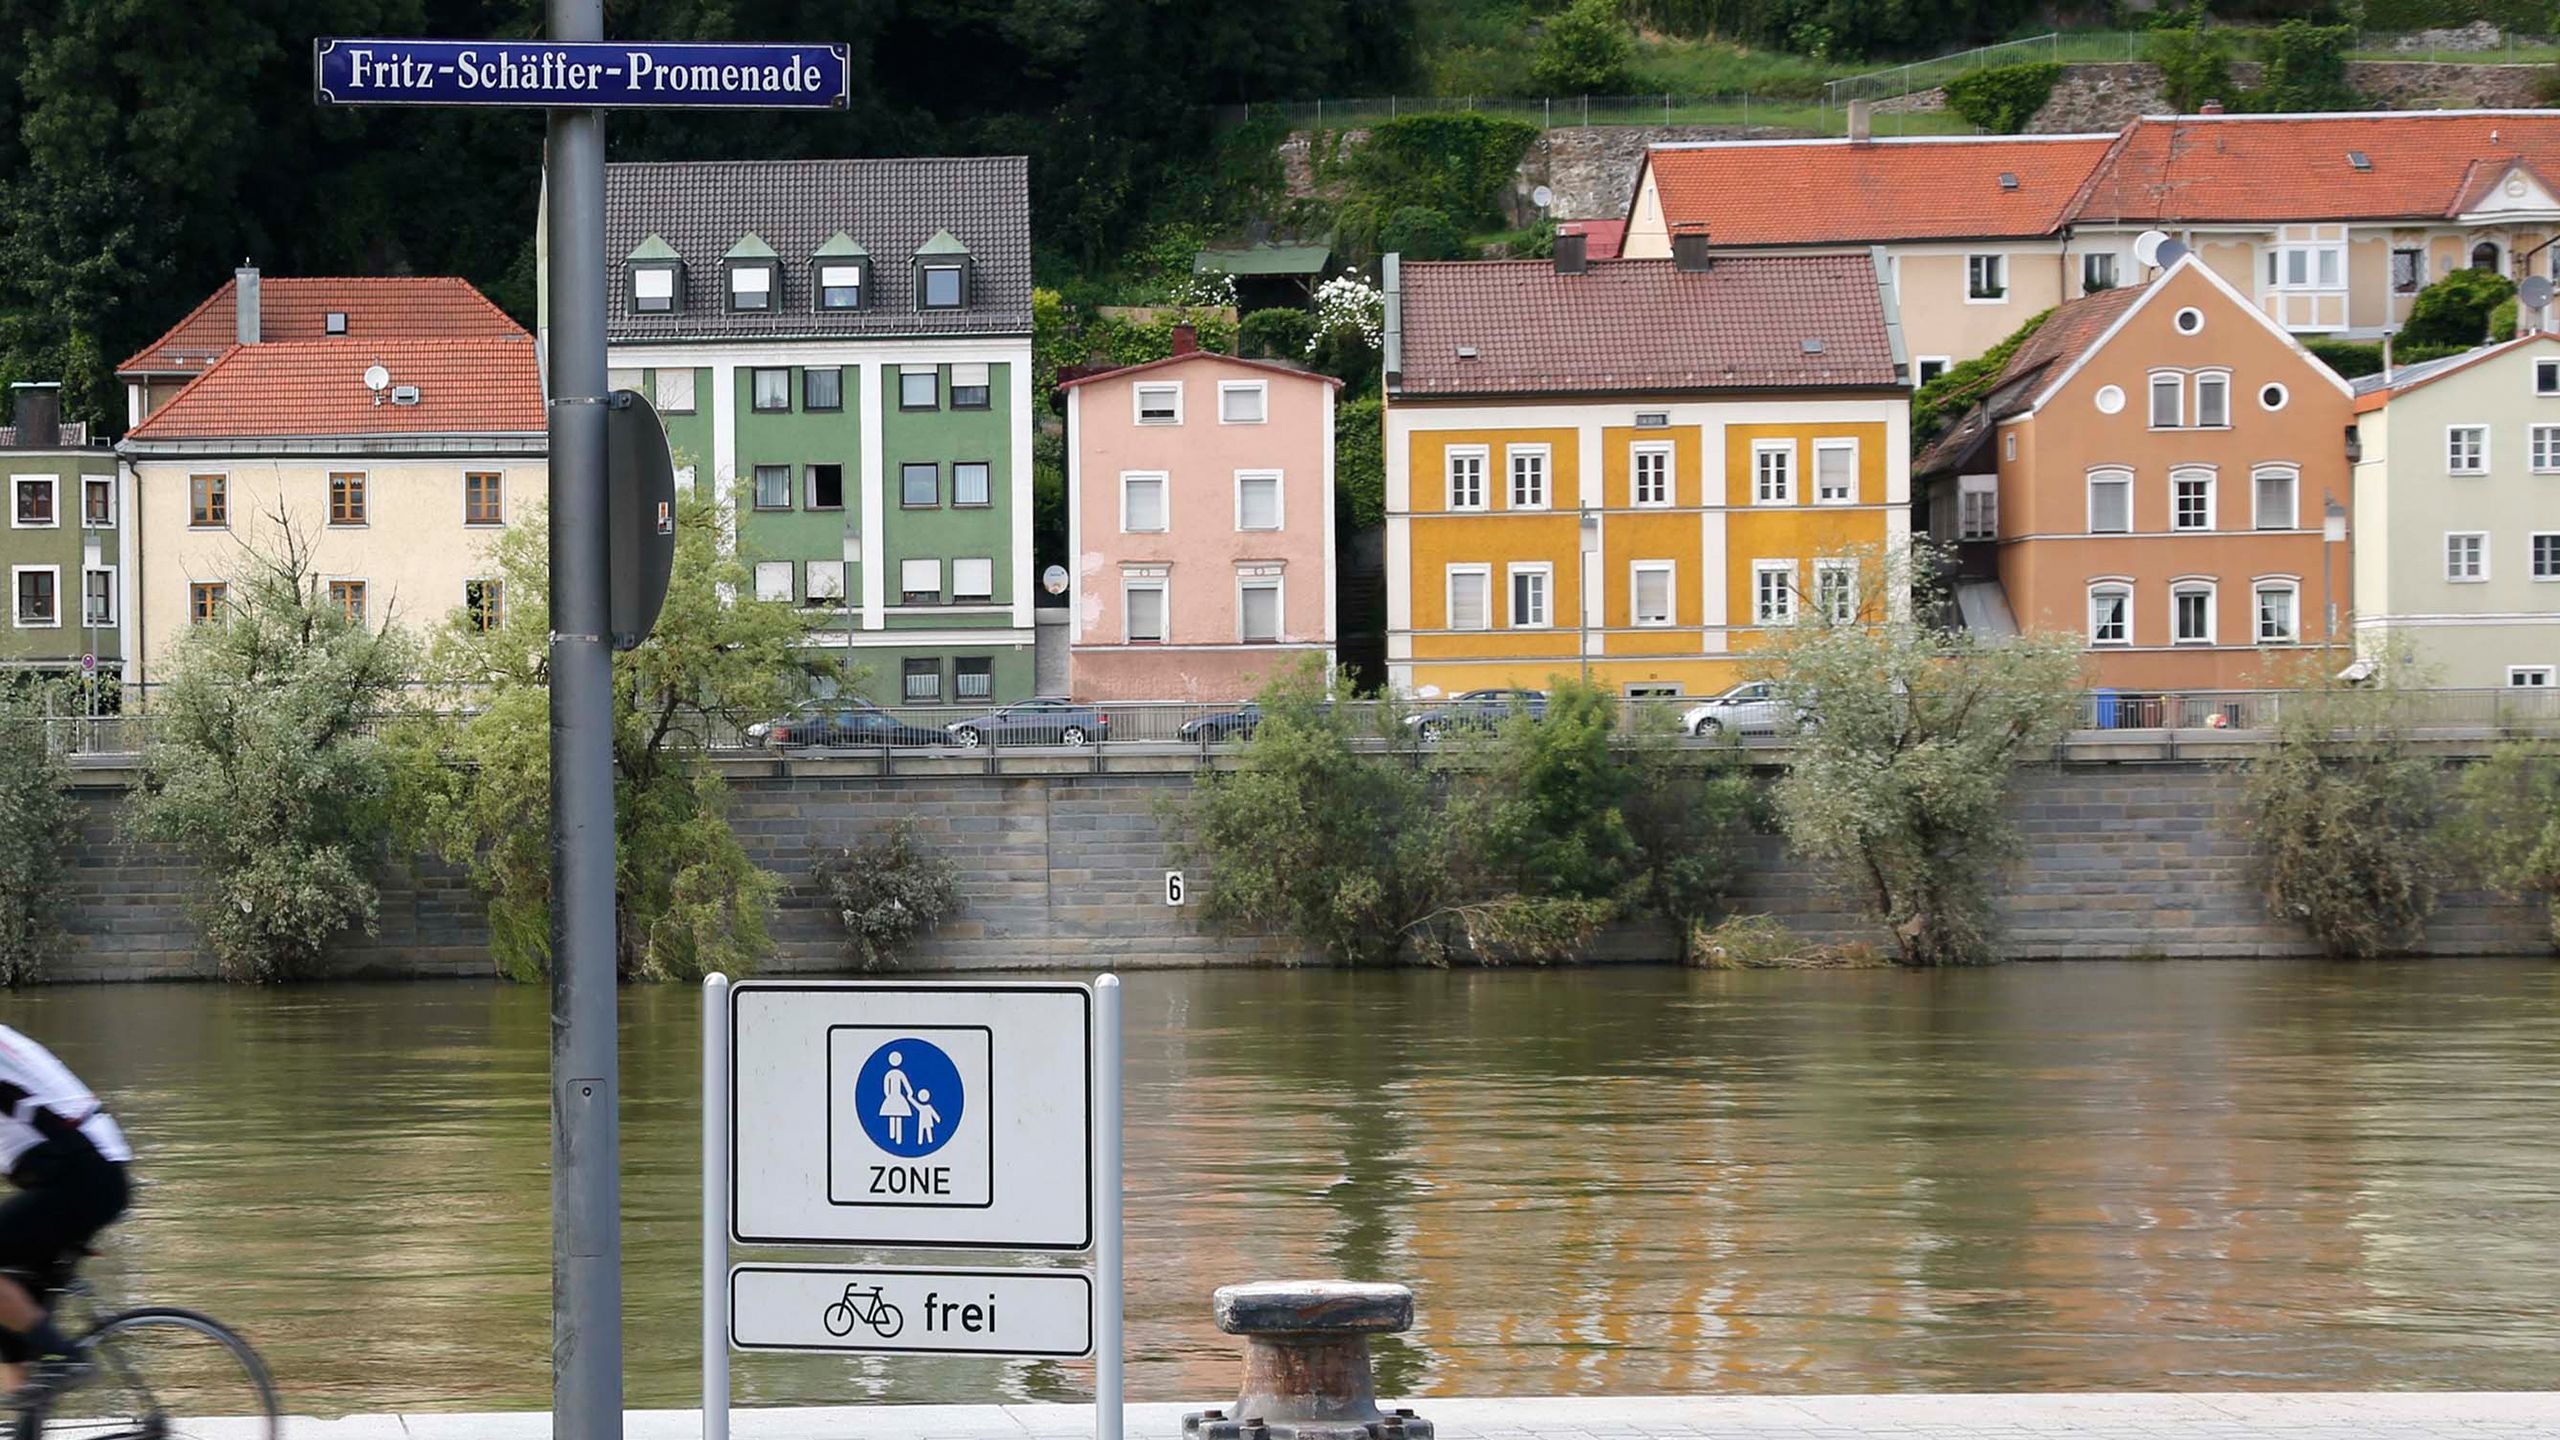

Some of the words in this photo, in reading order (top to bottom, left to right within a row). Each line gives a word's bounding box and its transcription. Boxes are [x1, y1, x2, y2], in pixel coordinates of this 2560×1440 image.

[348, 48, 822, 92] Fritz-Schäffer-Promenade
[1169, 875, 1181, 901] 6
[869, 1166, 951, 1195] ZONE
[924, 1292, 995, 1333] frei
